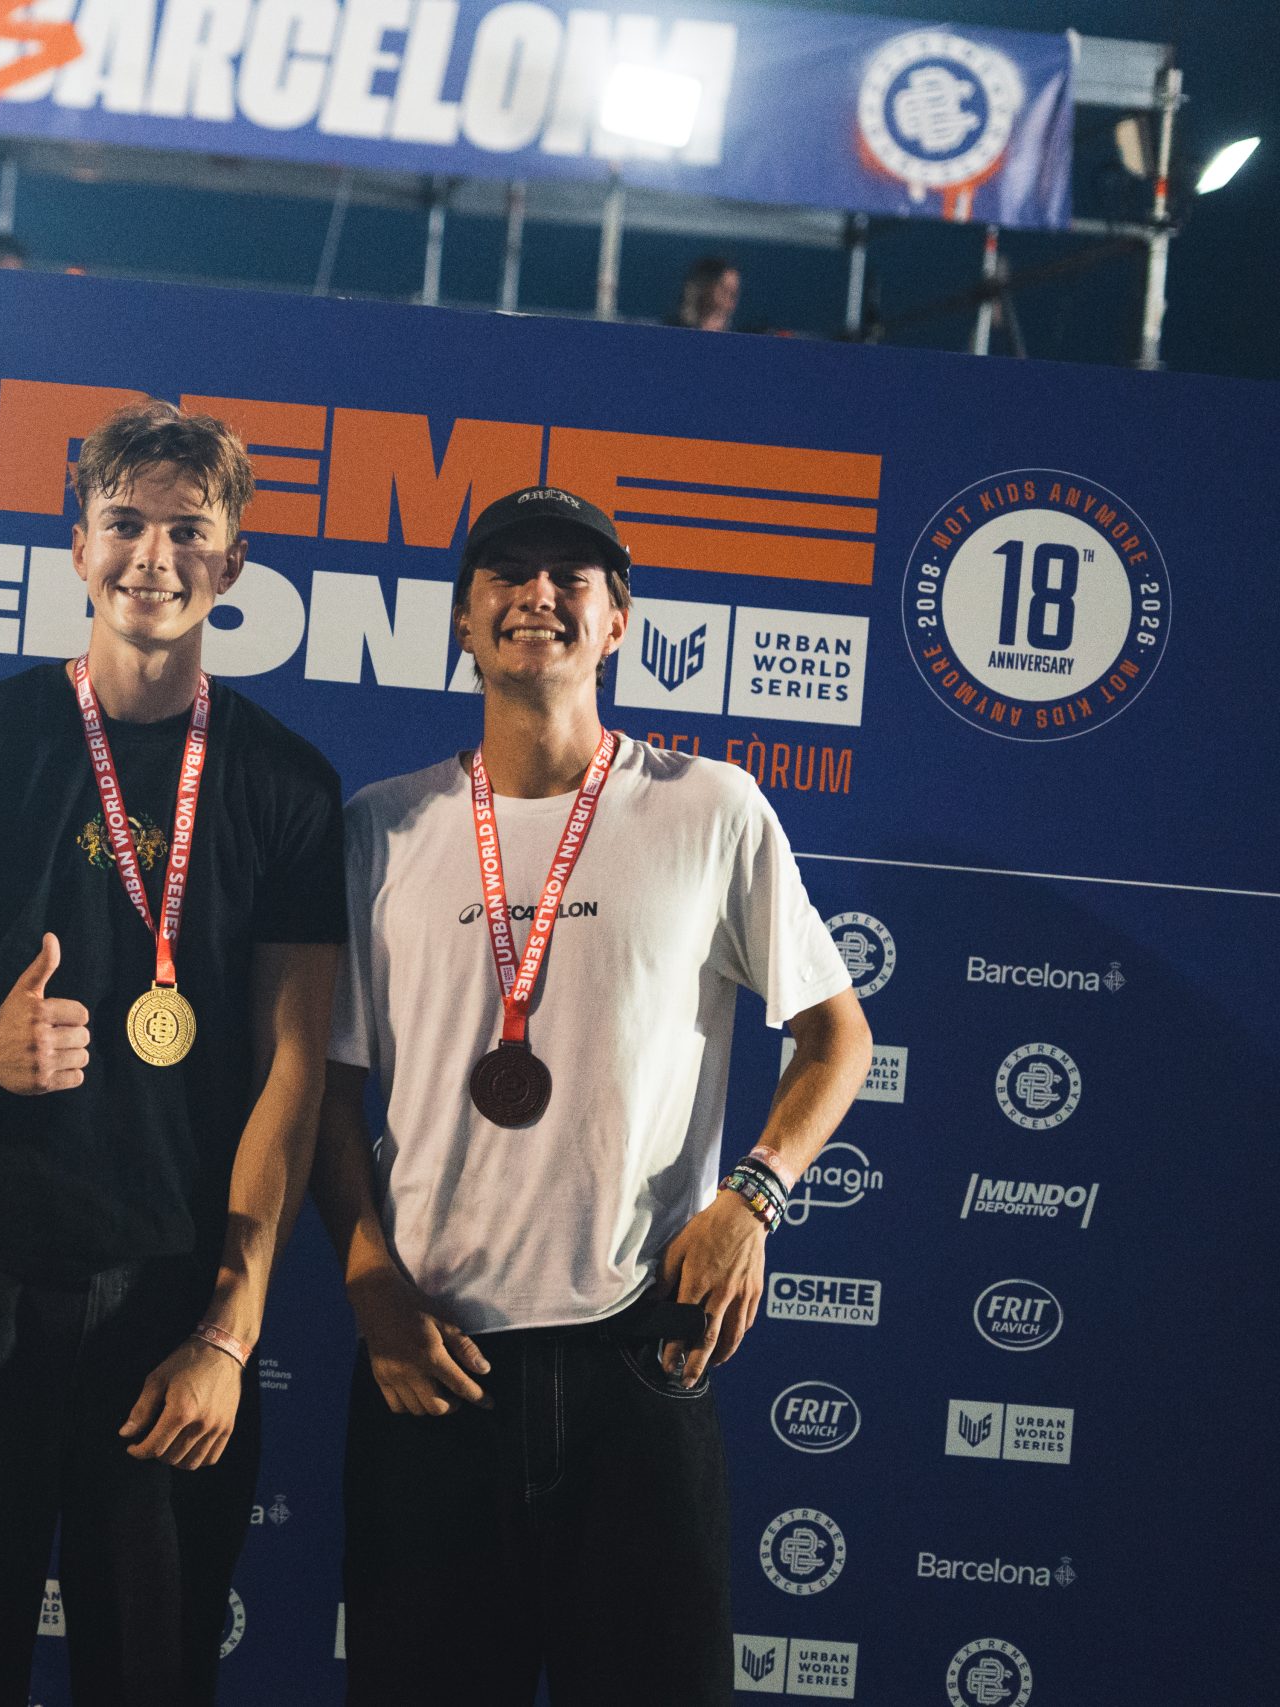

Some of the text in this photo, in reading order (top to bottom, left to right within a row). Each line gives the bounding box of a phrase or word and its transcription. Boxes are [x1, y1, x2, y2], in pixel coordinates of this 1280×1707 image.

[931, 480, 1149, 566] NOT KIDS ANYMORE
[916, 563, 941, 628] 2008
[1136, 582, 1161, 646] 2026
[755, 631, 851, 656] URBAN
[753, 654, 851, 678] WORLD
[987, 651, 1075, 676] ANNIVERSARY
[750, 677, 848, 701] SERIES
[923, 644, 1141, 729] NOT KIDS ANYMORE
[83, 709, 110, 772] SERIES
[596, 731, 615, 768] ERIES
[182, 730, 205, 793] URBAN
[473, 765, 491, 821] SERIES
[100, 776, 128, 849] WORLD
[171, 801, 195, 868] WORLD
[563, 797, 594, 859] URBAN
[479, 824, 500, 891] WORLD
[163, 872, 184, 940] SERIES
[535, 863, 570, 932] WORLD
[487, 894, 512, 962] URBAN
[827, 914, 892, 944] XTREME
[514, 935, 545, 1002] SERIES
[967, 956, 1099, 992] Barcelona
[868, 1069, 899, 1079] RLD
[872, 1056, 899, 1068] BAN
[1003, 1045, 1078, 1074] EXTREME
[865, 1080, 898, 1091] RIES
[997, 1087, 1080, 1128] BARCELONA
[804, 1166, 883, 1193] magin
[977, 1178, 1087, 1207] MUNDO
[974, 1201, 1059, 1217] DEPORTIVO
[773, 1277, 875, 1307] OSHEE
[771, 1302, 874, 1322] HYDRATION
[987, 1295, 1051, 1322] FRIT
[991, 1321, 1040, 1336] RAVICH
[784, 1397, 848, 1424] FRIT
[1015, 1416, 1066, 1428] URBAN
[788, 1422, 837, 1438] RAVICH
[1014, 1428, 1065, 1441] WORLD
[1013, 1440, 1064, 1452] SERIES
[767, 1510, 842, 1540] EXTREME
[761, 1552, 844, 1594] BARCELONA
[917, 1551, 1050, 1587] Barcelona
[798, 1662, 849, 1675] WORLD
[799, 1651, 850, 1663] URBAN
[954, 1640, 1028, 1669] EXTREME
[797, 1674, 848, 1687] SERIES
